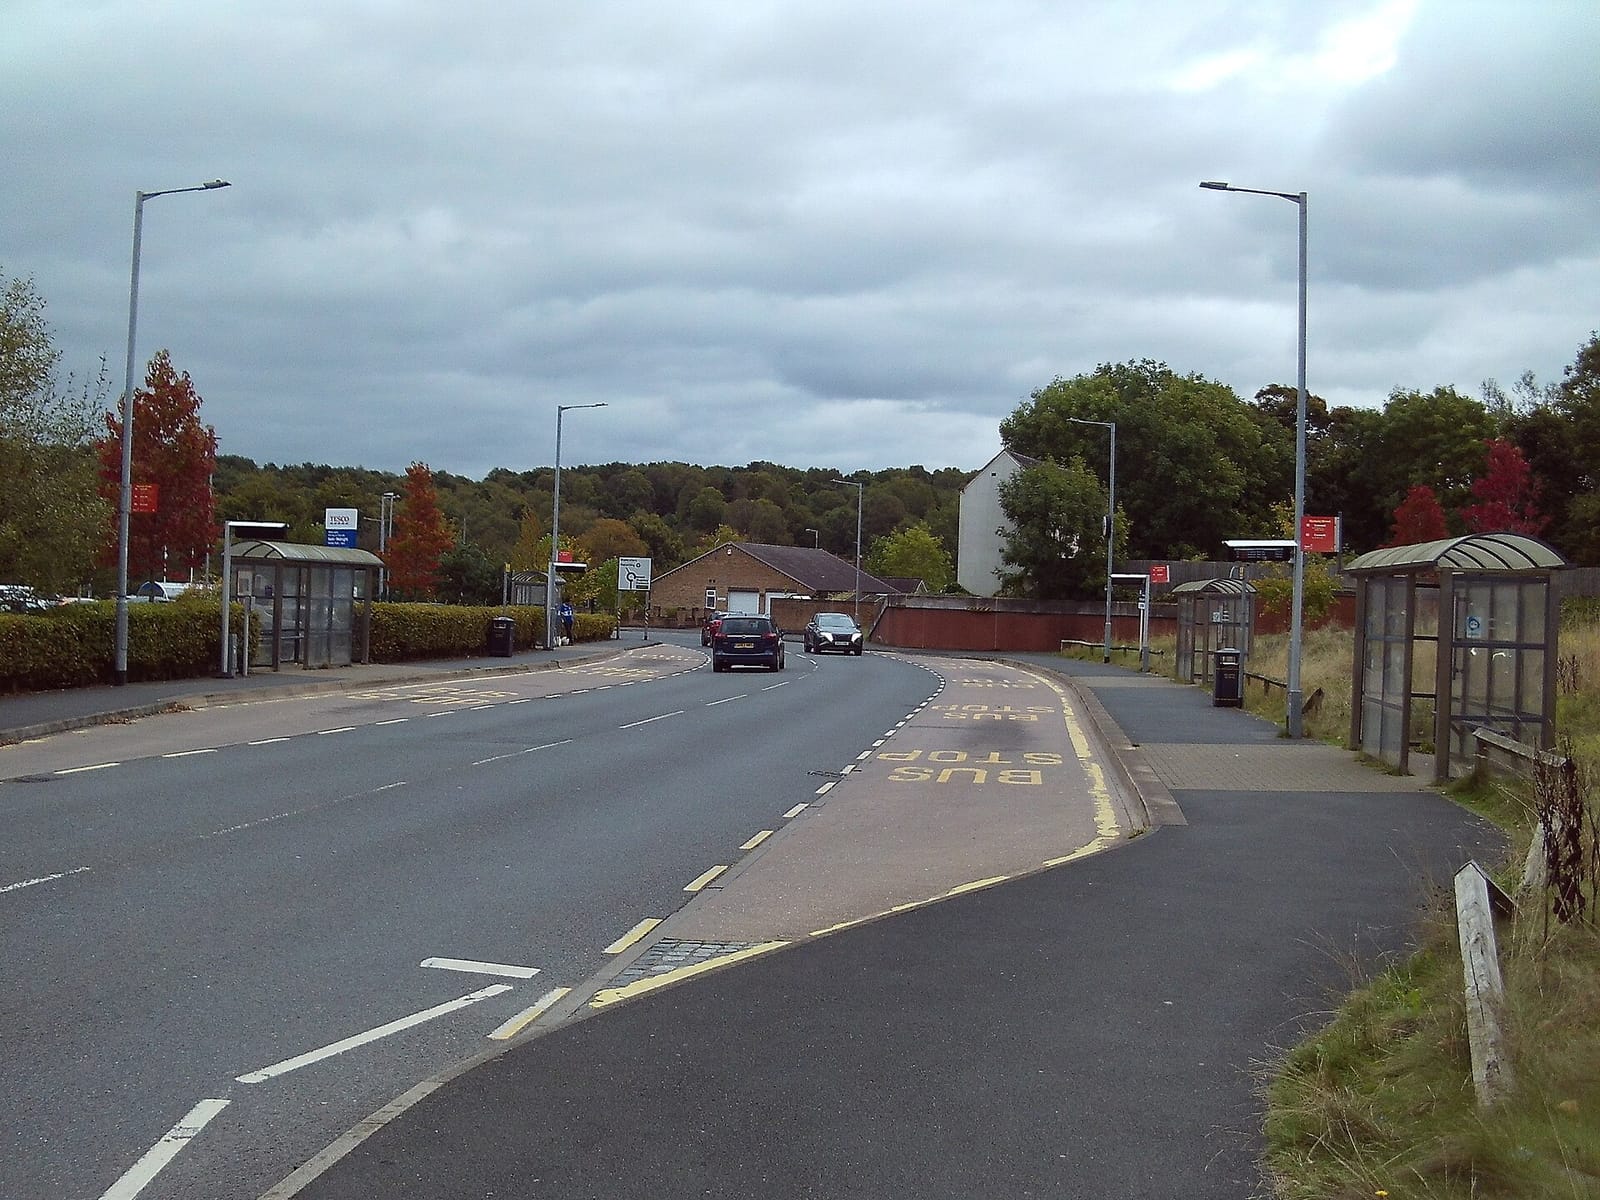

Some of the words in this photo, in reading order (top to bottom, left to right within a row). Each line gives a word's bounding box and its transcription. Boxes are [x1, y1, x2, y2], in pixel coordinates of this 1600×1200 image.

[931, 705, 1055, 713] STOP
[943, 713, 1038, 721] BUS
[877, 750, 1063, 765] STOP
[888, 767, 1042, 785] BUS
